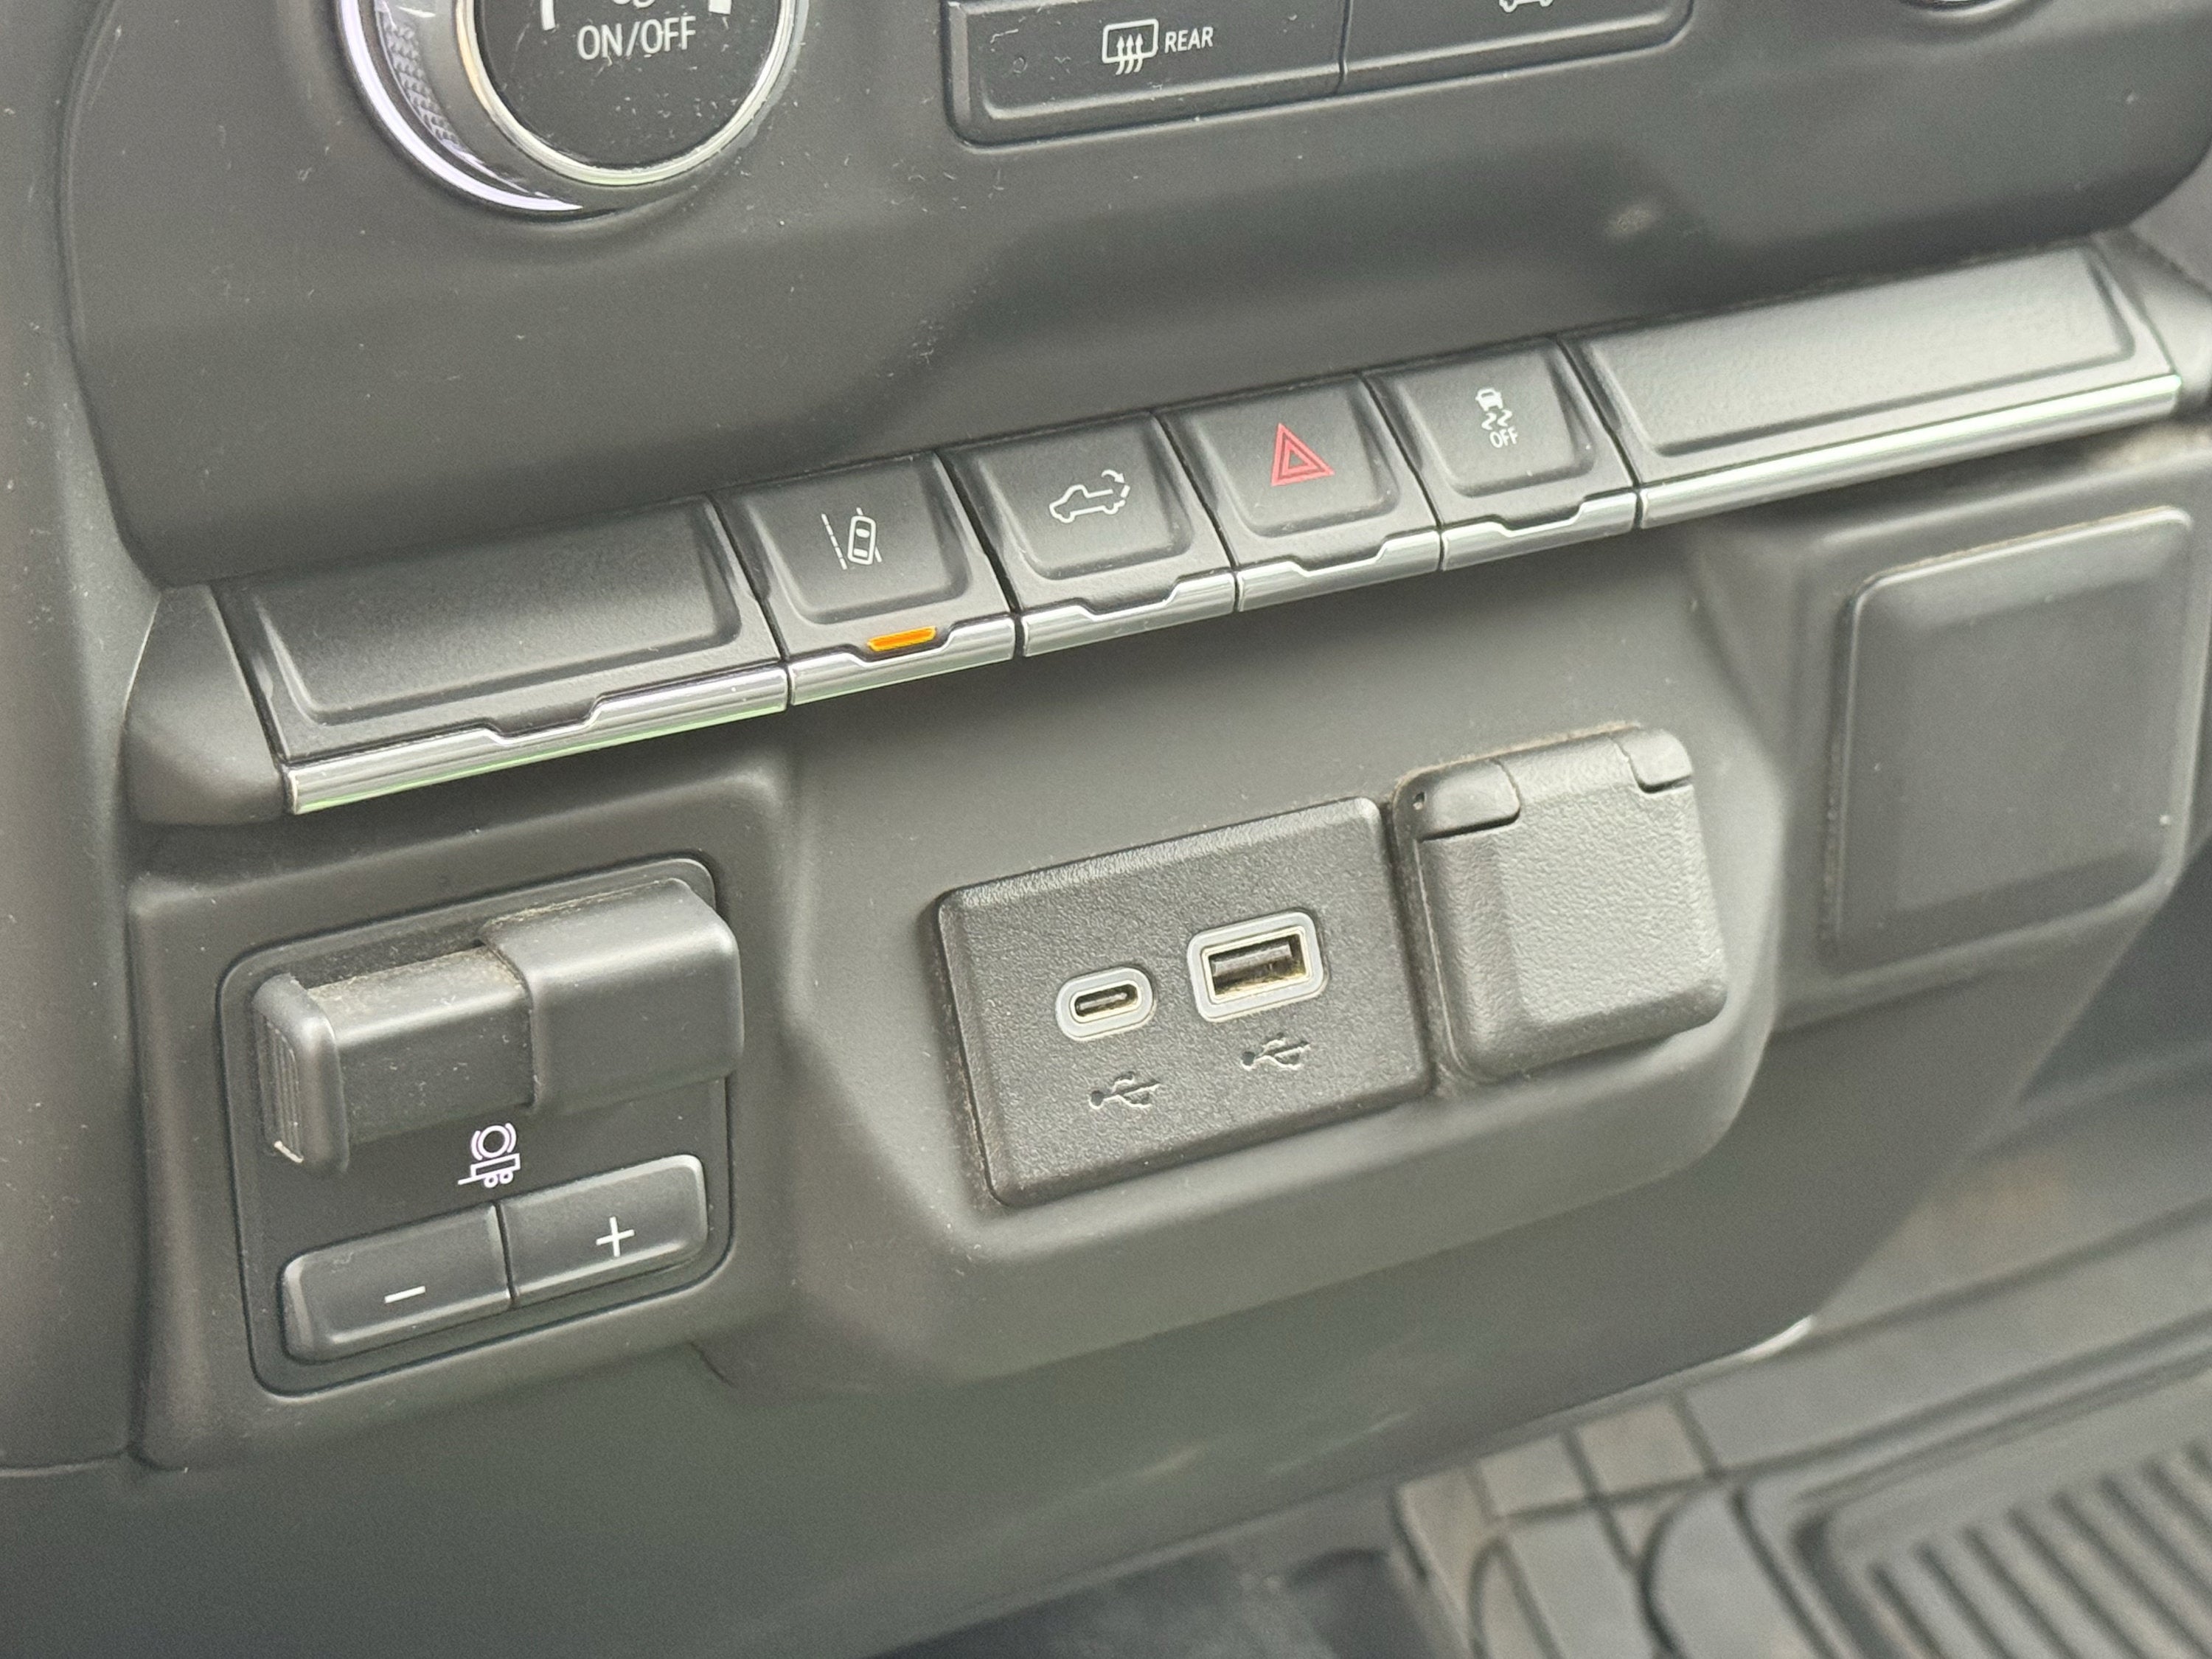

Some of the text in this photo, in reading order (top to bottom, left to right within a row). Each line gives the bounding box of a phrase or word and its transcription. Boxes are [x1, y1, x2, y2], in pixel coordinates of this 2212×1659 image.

[577, 15, 696, 60] ON/OFF
[1164, 27, 1214, 54] REAR
[1489, 425, 1518, 448] OFF
